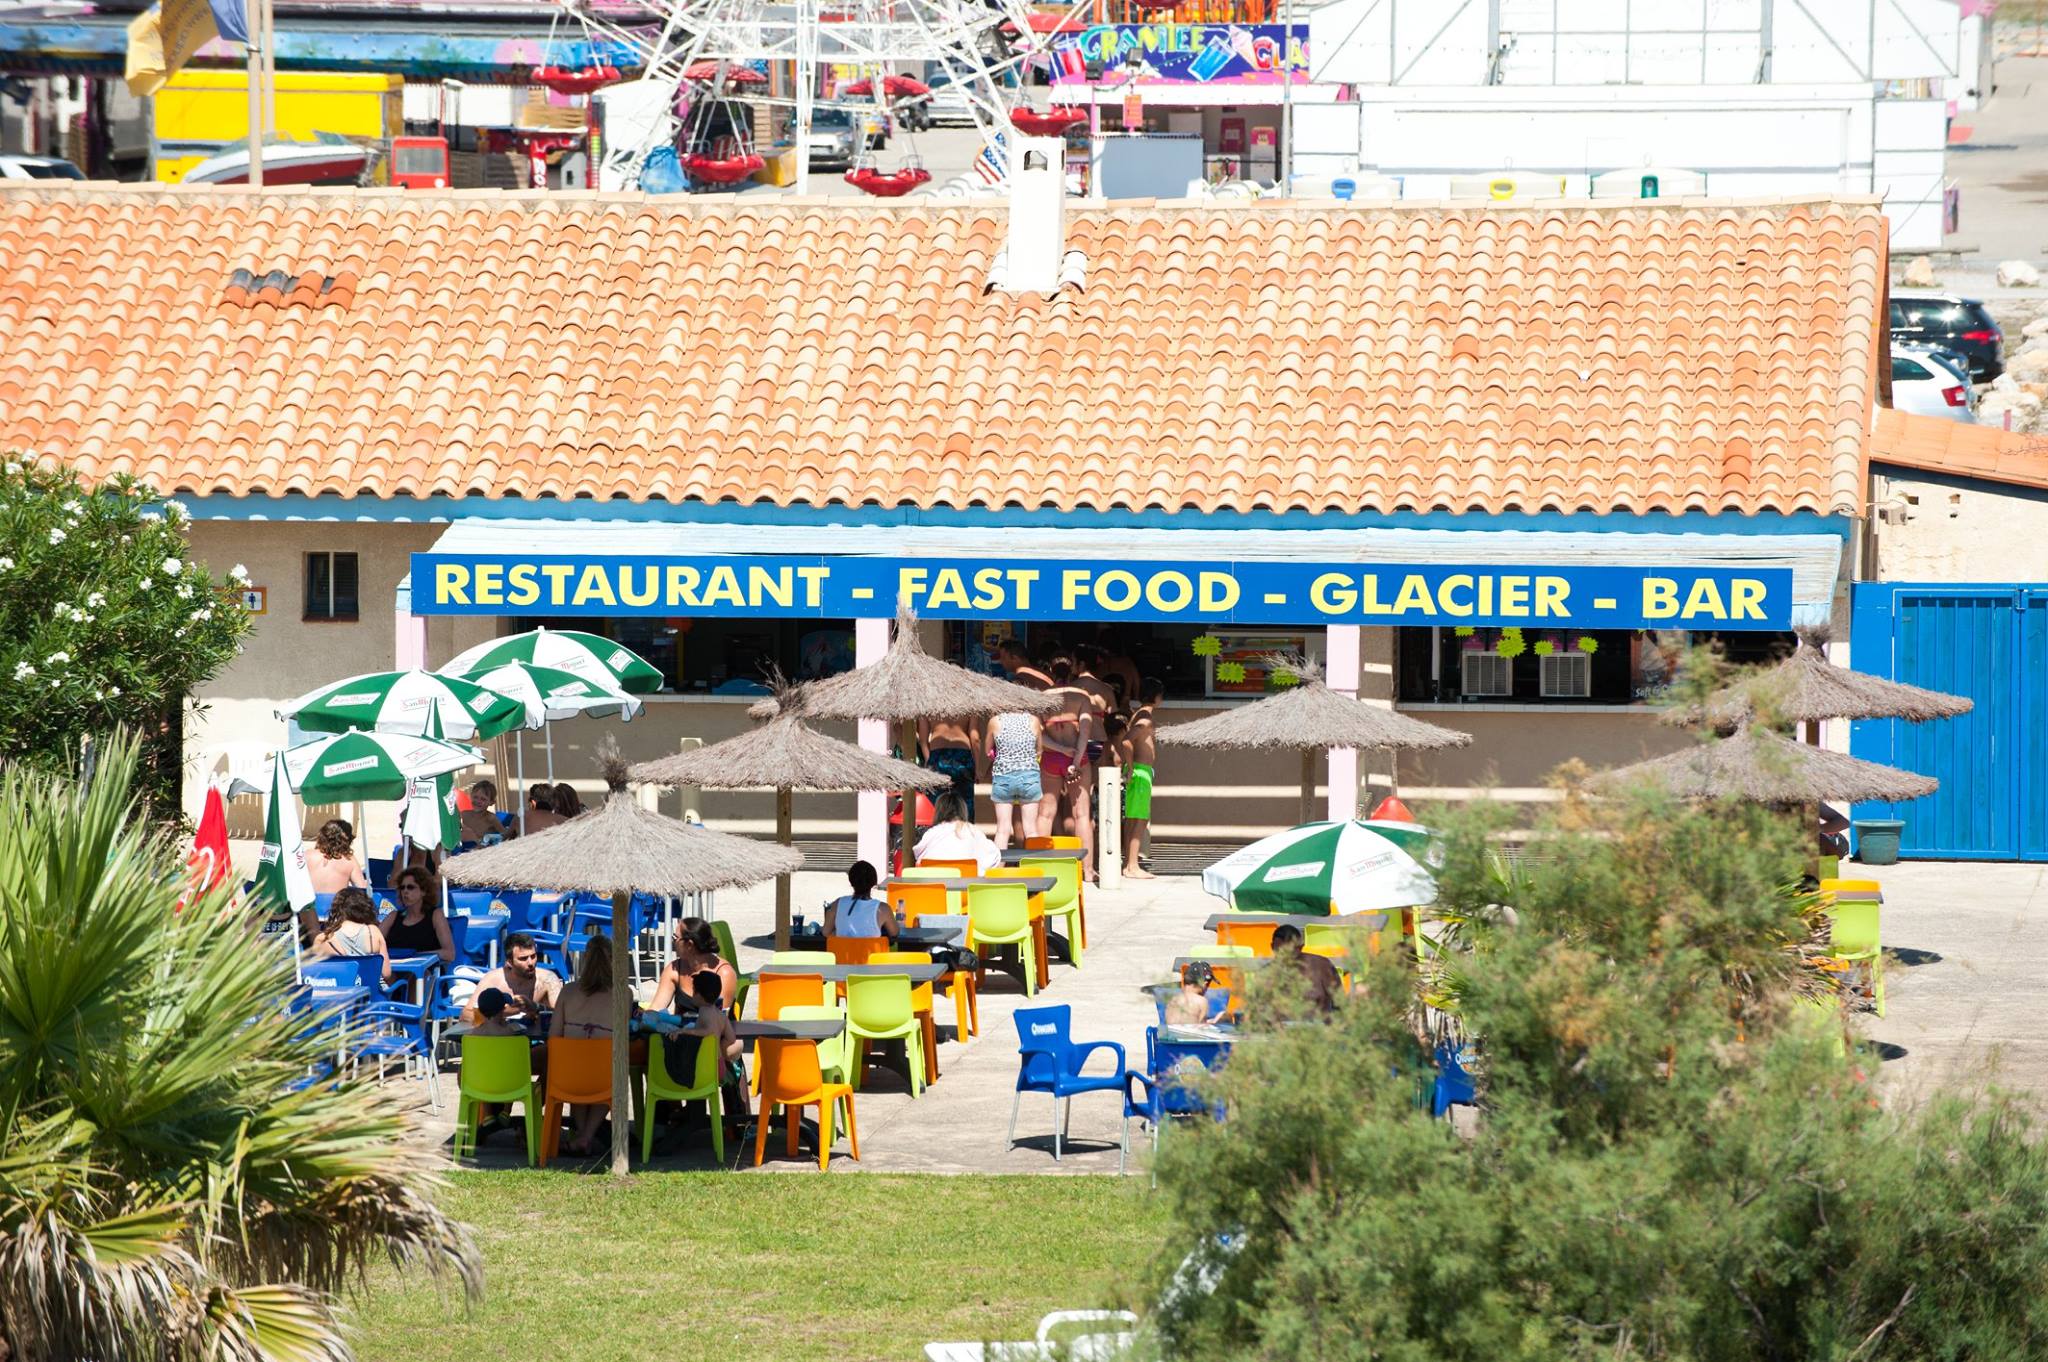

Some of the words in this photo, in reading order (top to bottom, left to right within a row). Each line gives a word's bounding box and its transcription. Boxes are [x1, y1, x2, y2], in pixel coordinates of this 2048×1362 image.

[435, 564, 830, 607] RESTAURANT
[852, 588, 874, 599] -
[897, 568, 1040, 612] FAST
[1062, 570, 1241, 612] FOOD
[1264, 593, 1286, 604] -
[1310, 572, 1571, 617] GLACIER
[1593, 598, 1617, 609] -
[1642, 577, 1767, 620] BAR
